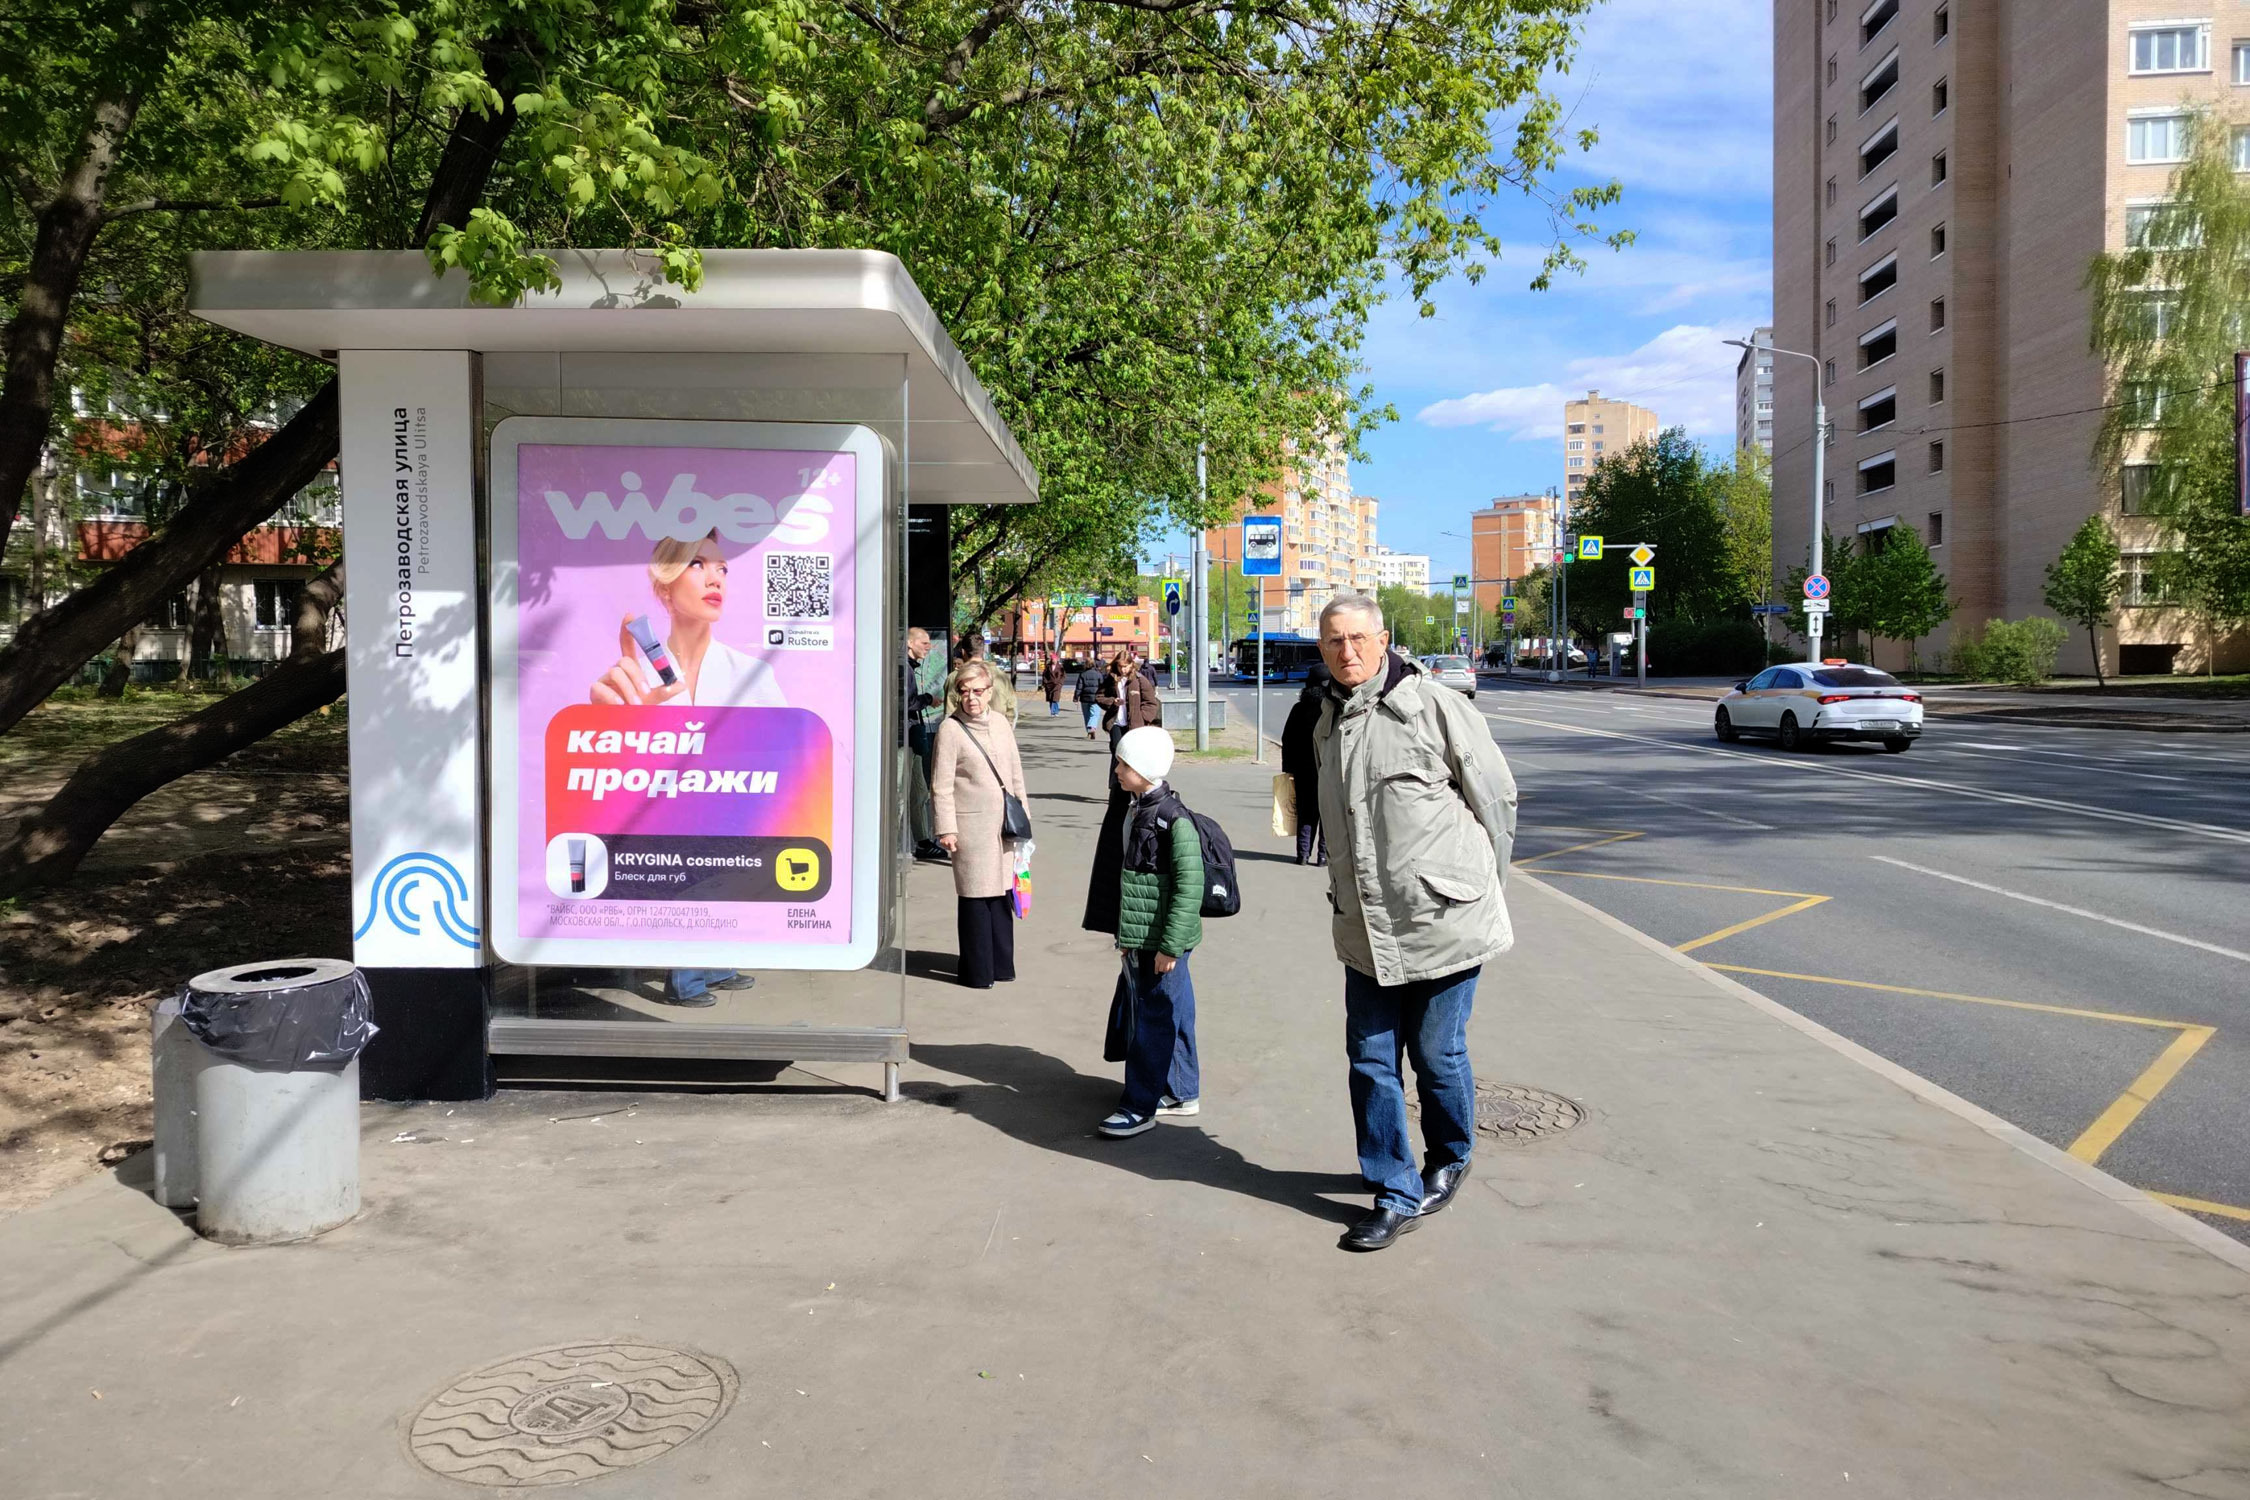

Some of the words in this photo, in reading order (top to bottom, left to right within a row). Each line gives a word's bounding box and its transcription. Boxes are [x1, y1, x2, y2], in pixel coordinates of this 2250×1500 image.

[414, 407, 427, 449] Ulitsa
[394, 407, 413, 473] улица
[798, 468, 842, 488] 12+
[415, 454, 430, 574] Petrozavodskaya
[544, 471, 834, 545] wibes
[395, 479, 416, 658] Петрозаводская
[788, 637, 829, 646] RuStore
[567, 721, 706, 755] качай
[567, 768, 779, 800] продажи
[614, 853, 683, 866] KRYGINA
[686, 854, 762, 867] cosmetics
[614, 871, 645, 881] Блеск
[647, 873, 667, 883] для
[669, 872, 687, 883] губ
[579, 904, 597, 915] ООО
[627, 906, 647, 916] ОГРН
[787, 908, 817, 918] ЕЛЕНА
[549, 915, 602, 926] МОСКОВСКАЯ
[787, 919, 832, 929] КРЫГИНА
